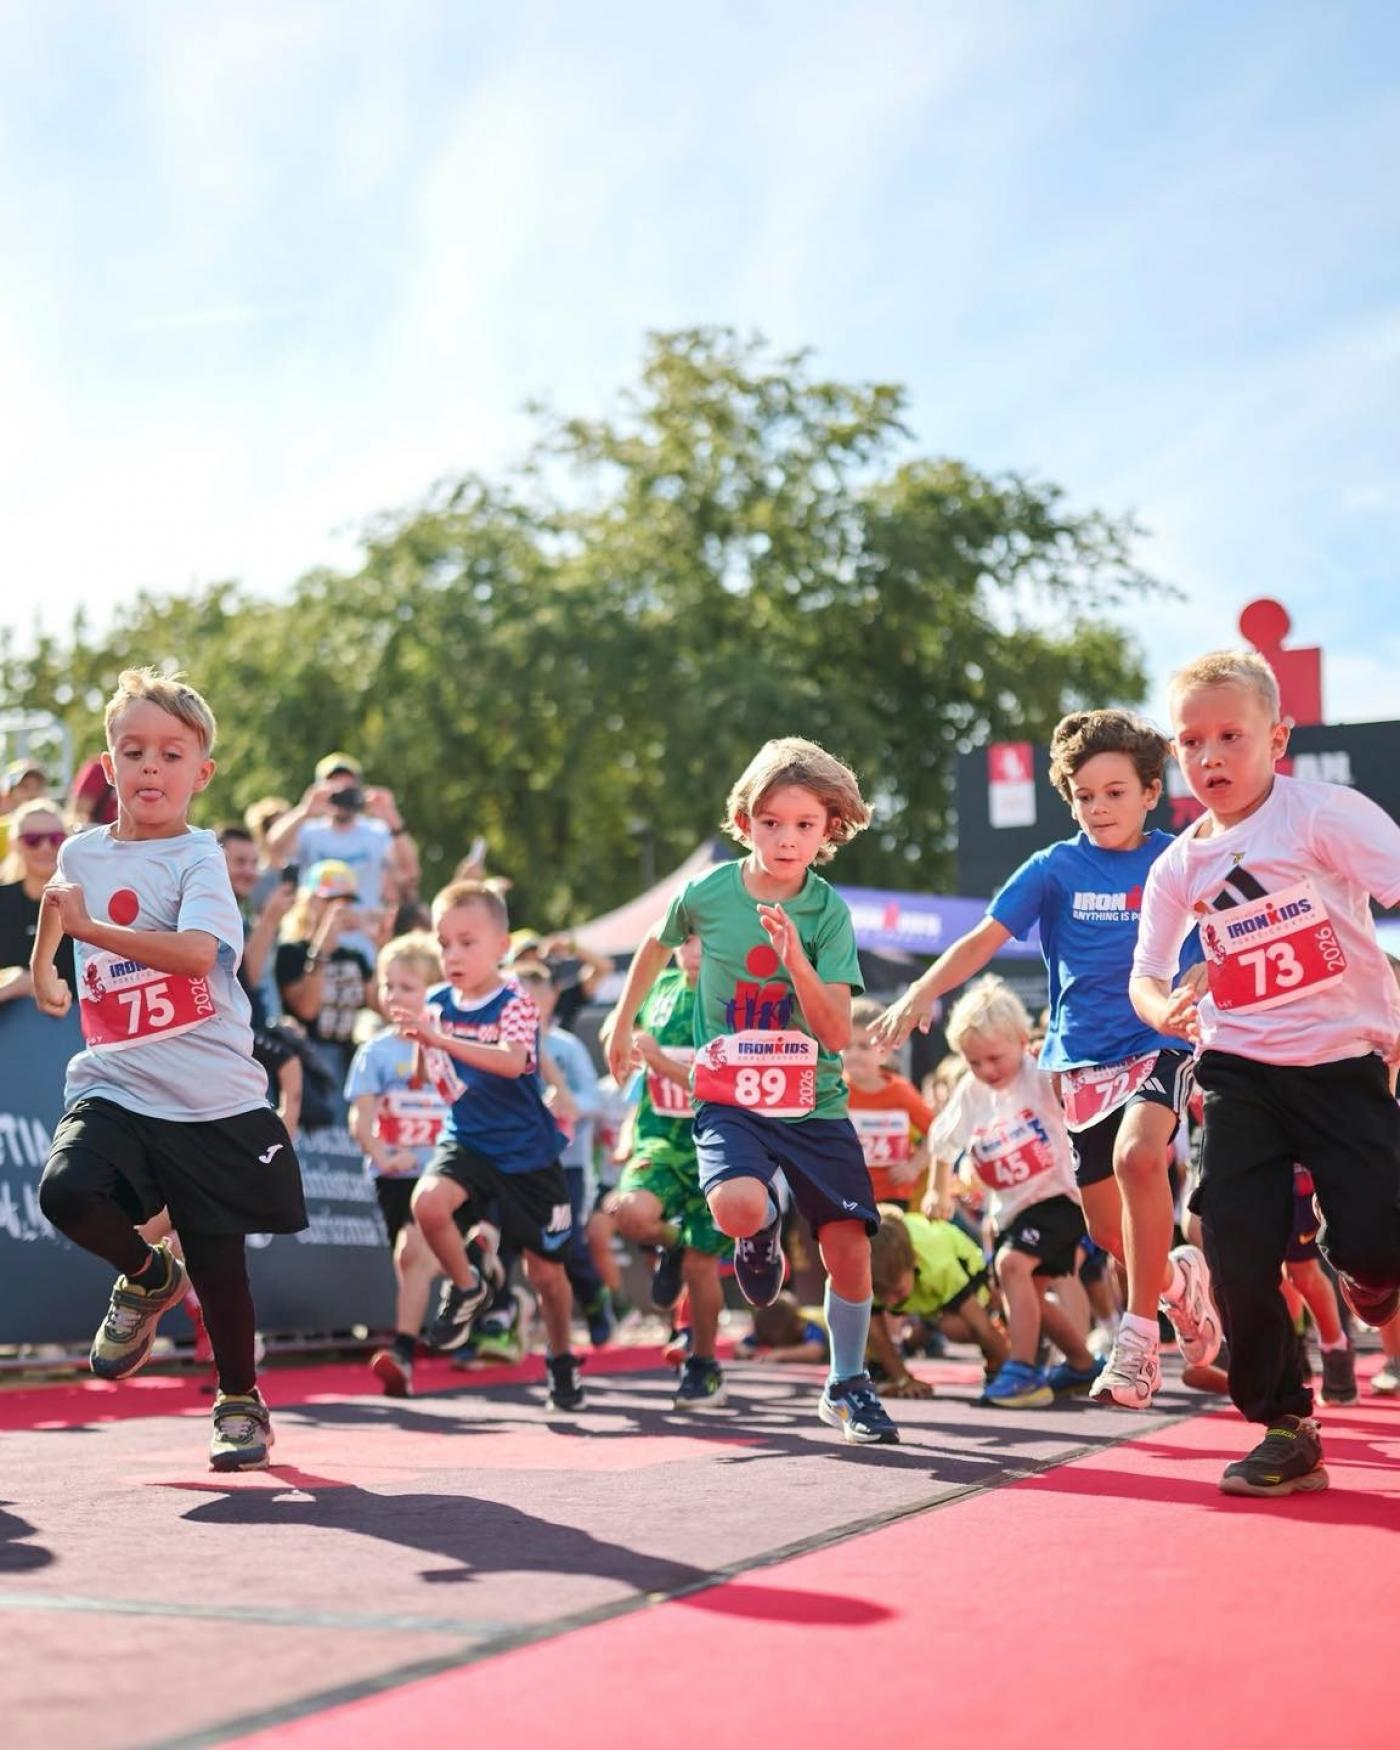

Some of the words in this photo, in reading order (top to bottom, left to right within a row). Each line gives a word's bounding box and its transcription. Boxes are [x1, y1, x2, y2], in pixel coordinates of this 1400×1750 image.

[1073, 910, 1119, 921] ANYTHING
[1121, 911, 1130, 921] IS
[1227, 899, 1312, 938] IRONKIDS
[1315, 926, 1345, 971] 2026
[1238, 943, 1304, 997] 73
[118, 982, 175, 1035] 75
[738, 1038, 809, 1055] IRONKIDS
[735, 1068, 788, 1106] 89
[800, 1070, 814, 1106] 2026
[1096, 1073, 1129, 1112] 72
[399, 1120, 433, 1146] 22
[995, 1150, 1030, 1185] 45
